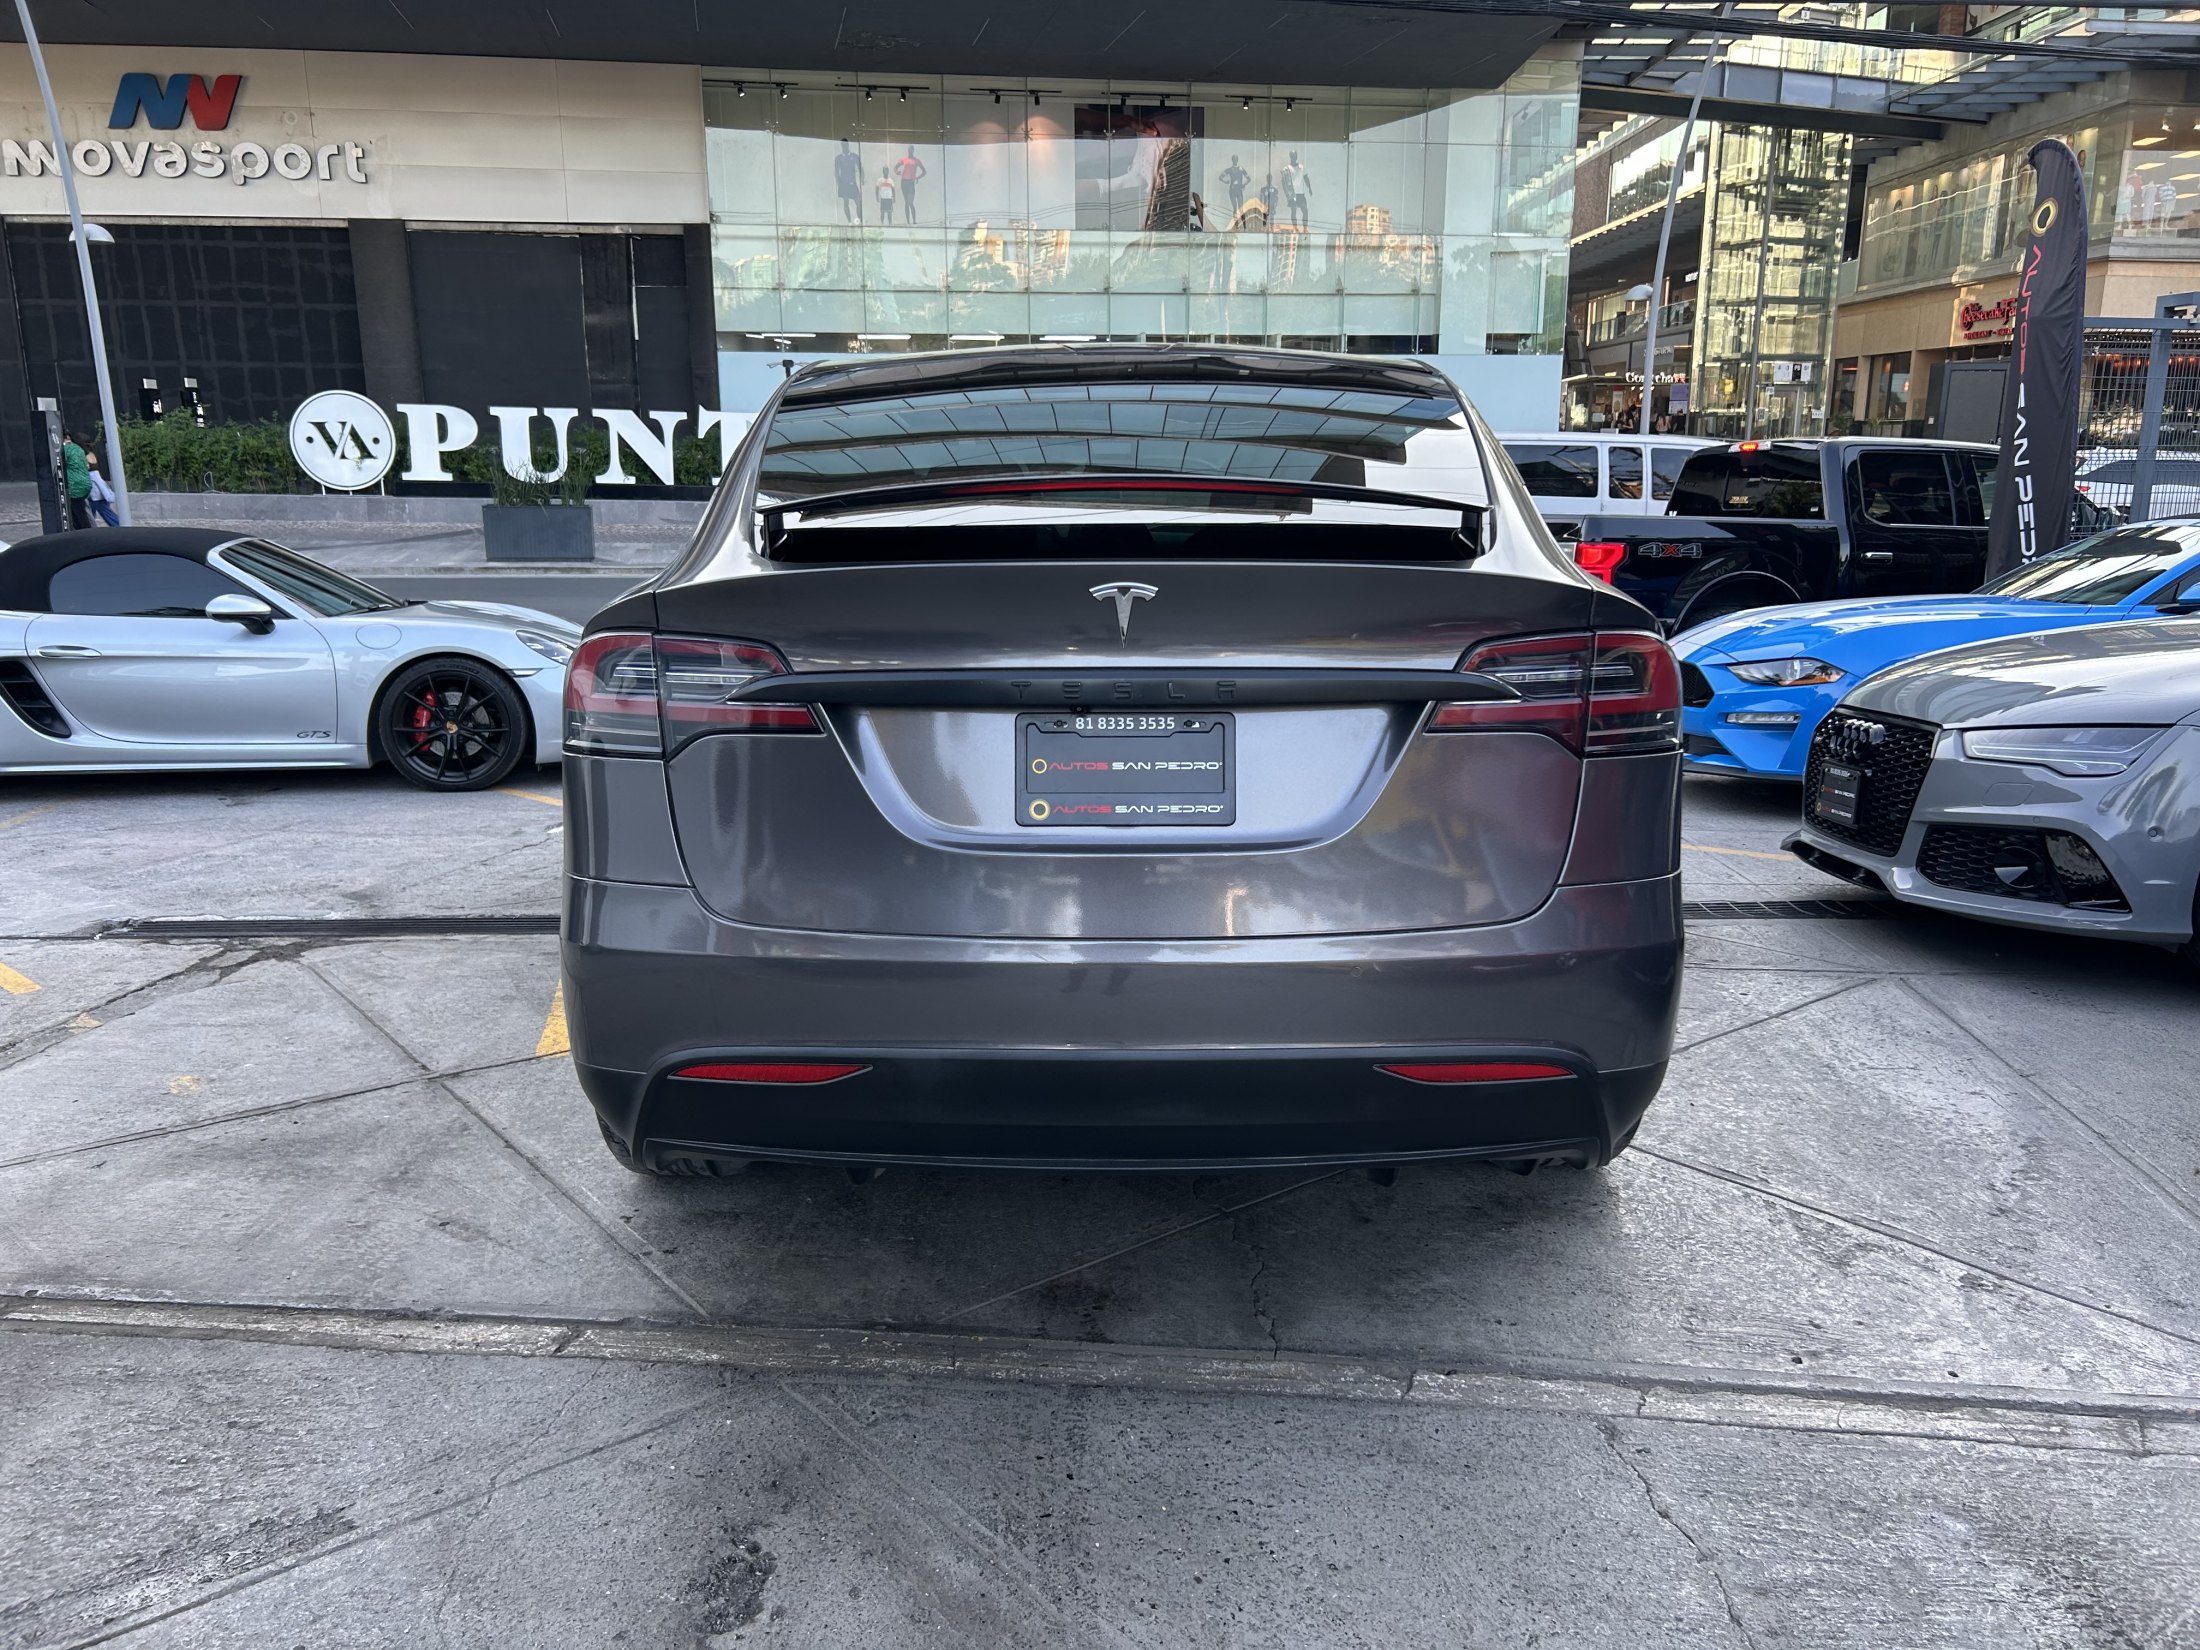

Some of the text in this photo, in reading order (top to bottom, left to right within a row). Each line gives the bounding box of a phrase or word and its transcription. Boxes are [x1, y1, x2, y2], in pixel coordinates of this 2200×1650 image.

[1011, 680, 1237, 700] TESLA
[1075, 717, 1175, 730] 81 8335 3535
[296, 730, 332, 739] GTS
[1049, 761, 1109, 771] AUTOS
[1112, 761, 1151, 771] SAN
[1053, 804, 1113, 814] AUTOS
[1115, 804, 1153, 814] SAN
